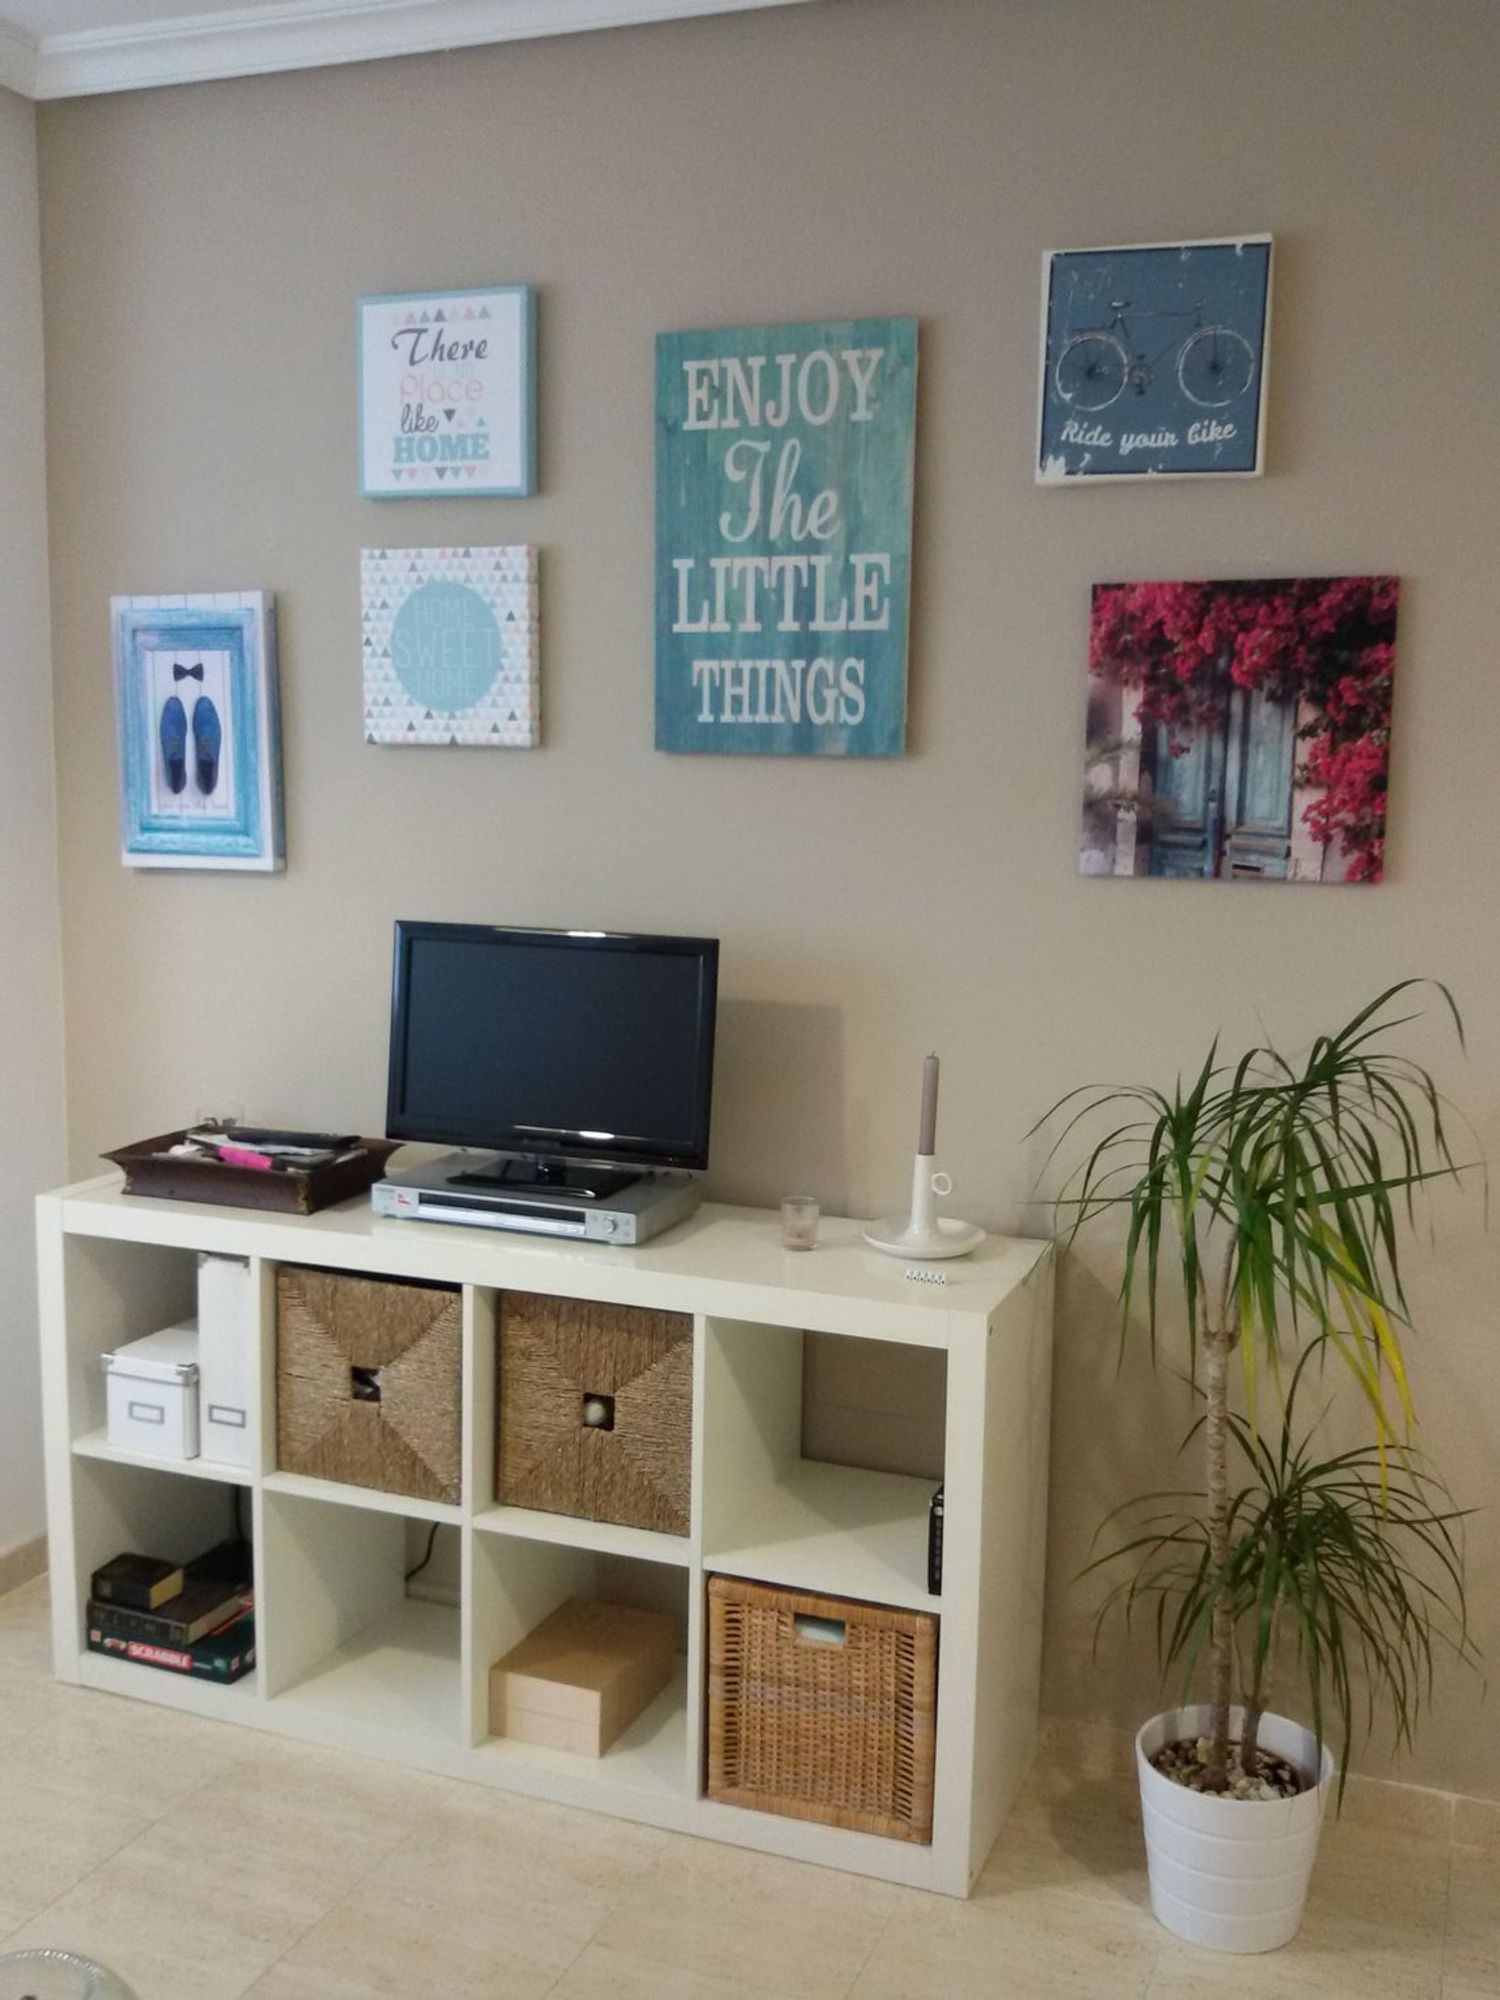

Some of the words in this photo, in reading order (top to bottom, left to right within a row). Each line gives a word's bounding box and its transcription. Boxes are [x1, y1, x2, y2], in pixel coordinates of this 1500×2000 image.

[391, 328, 488, 366] There
[683, 348, 884, 430] ENJOY
[401, 403, 439, 434] like
[1061, 419, 1113, 447] Ride
[1119, 431, 1179, 456] your
[1187, 420, 1237, 445] bike
[393, 433, 490, 463] HOME
[719, 438, 841, 543] The
[672, 553, 890, 633] LITTLE
[395, 628, 496, 669] SWEET
[692, 658, 865, 726] THINGS
